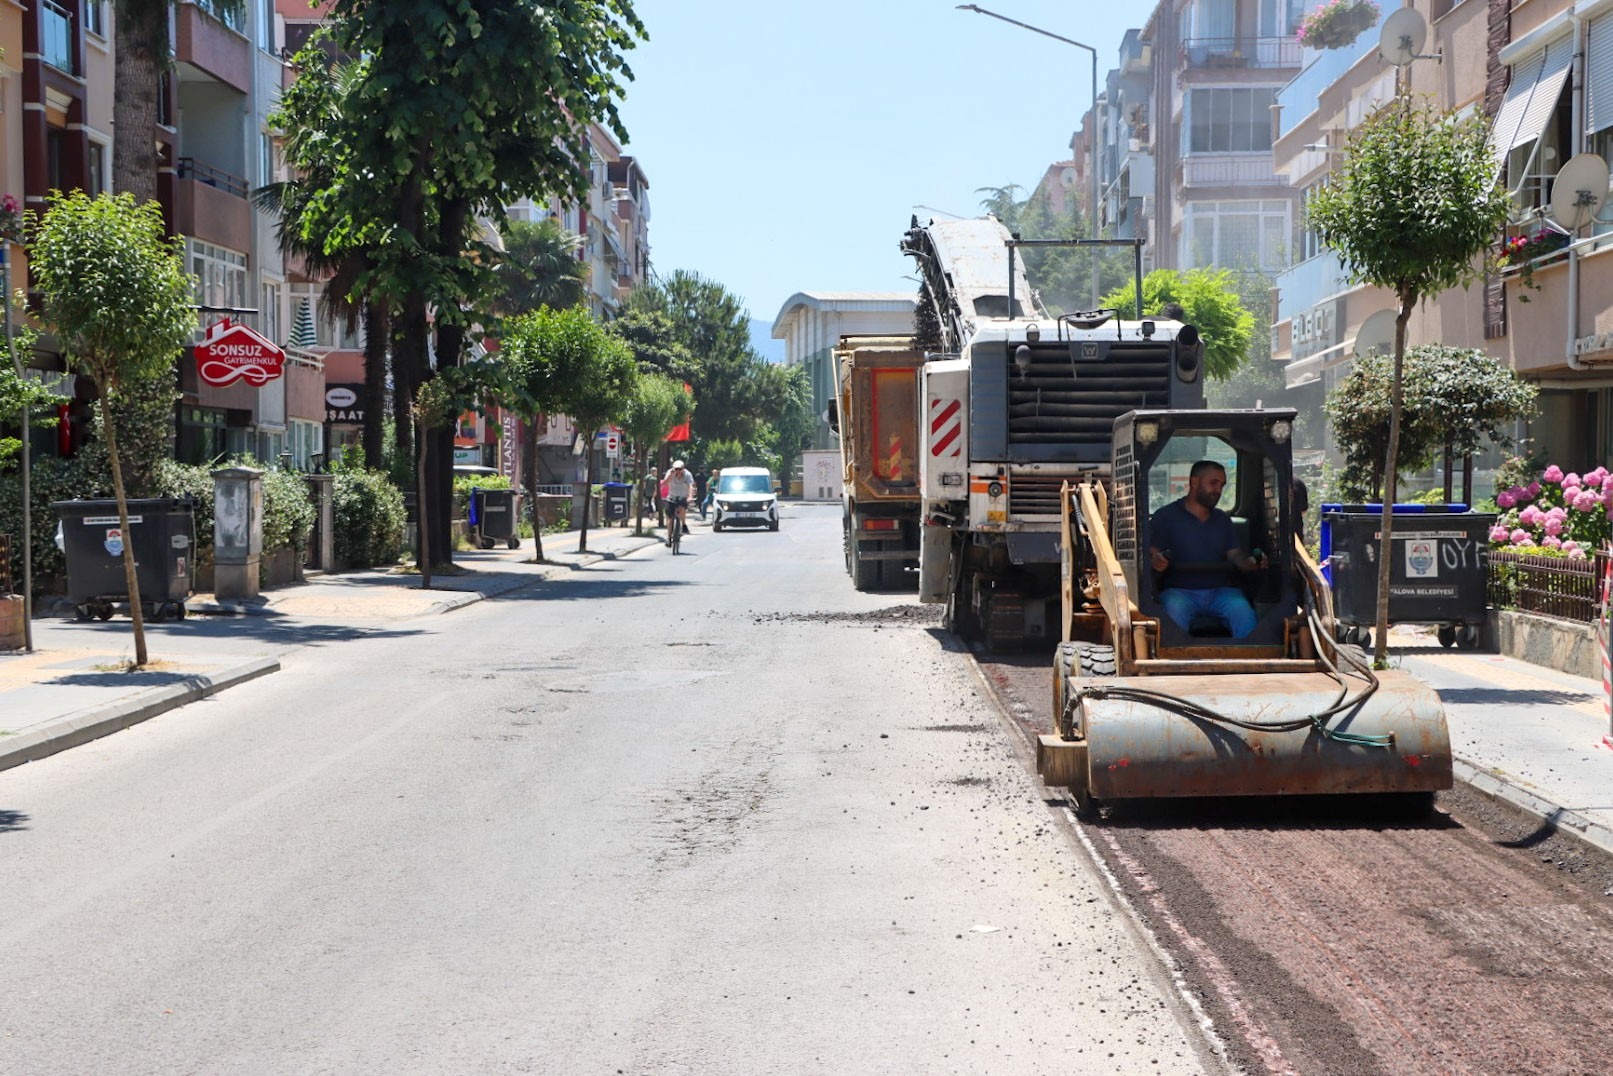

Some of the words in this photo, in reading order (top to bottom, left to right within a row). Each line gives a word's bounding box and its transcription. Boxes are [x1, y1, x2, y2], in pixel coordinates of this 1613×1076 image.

[209, 344, 262, 356] SONSUZ
[224, 356, 277, 366] GAYRİMENKUL
[1416, 587, 1454, 595] BELEDİYESİ
